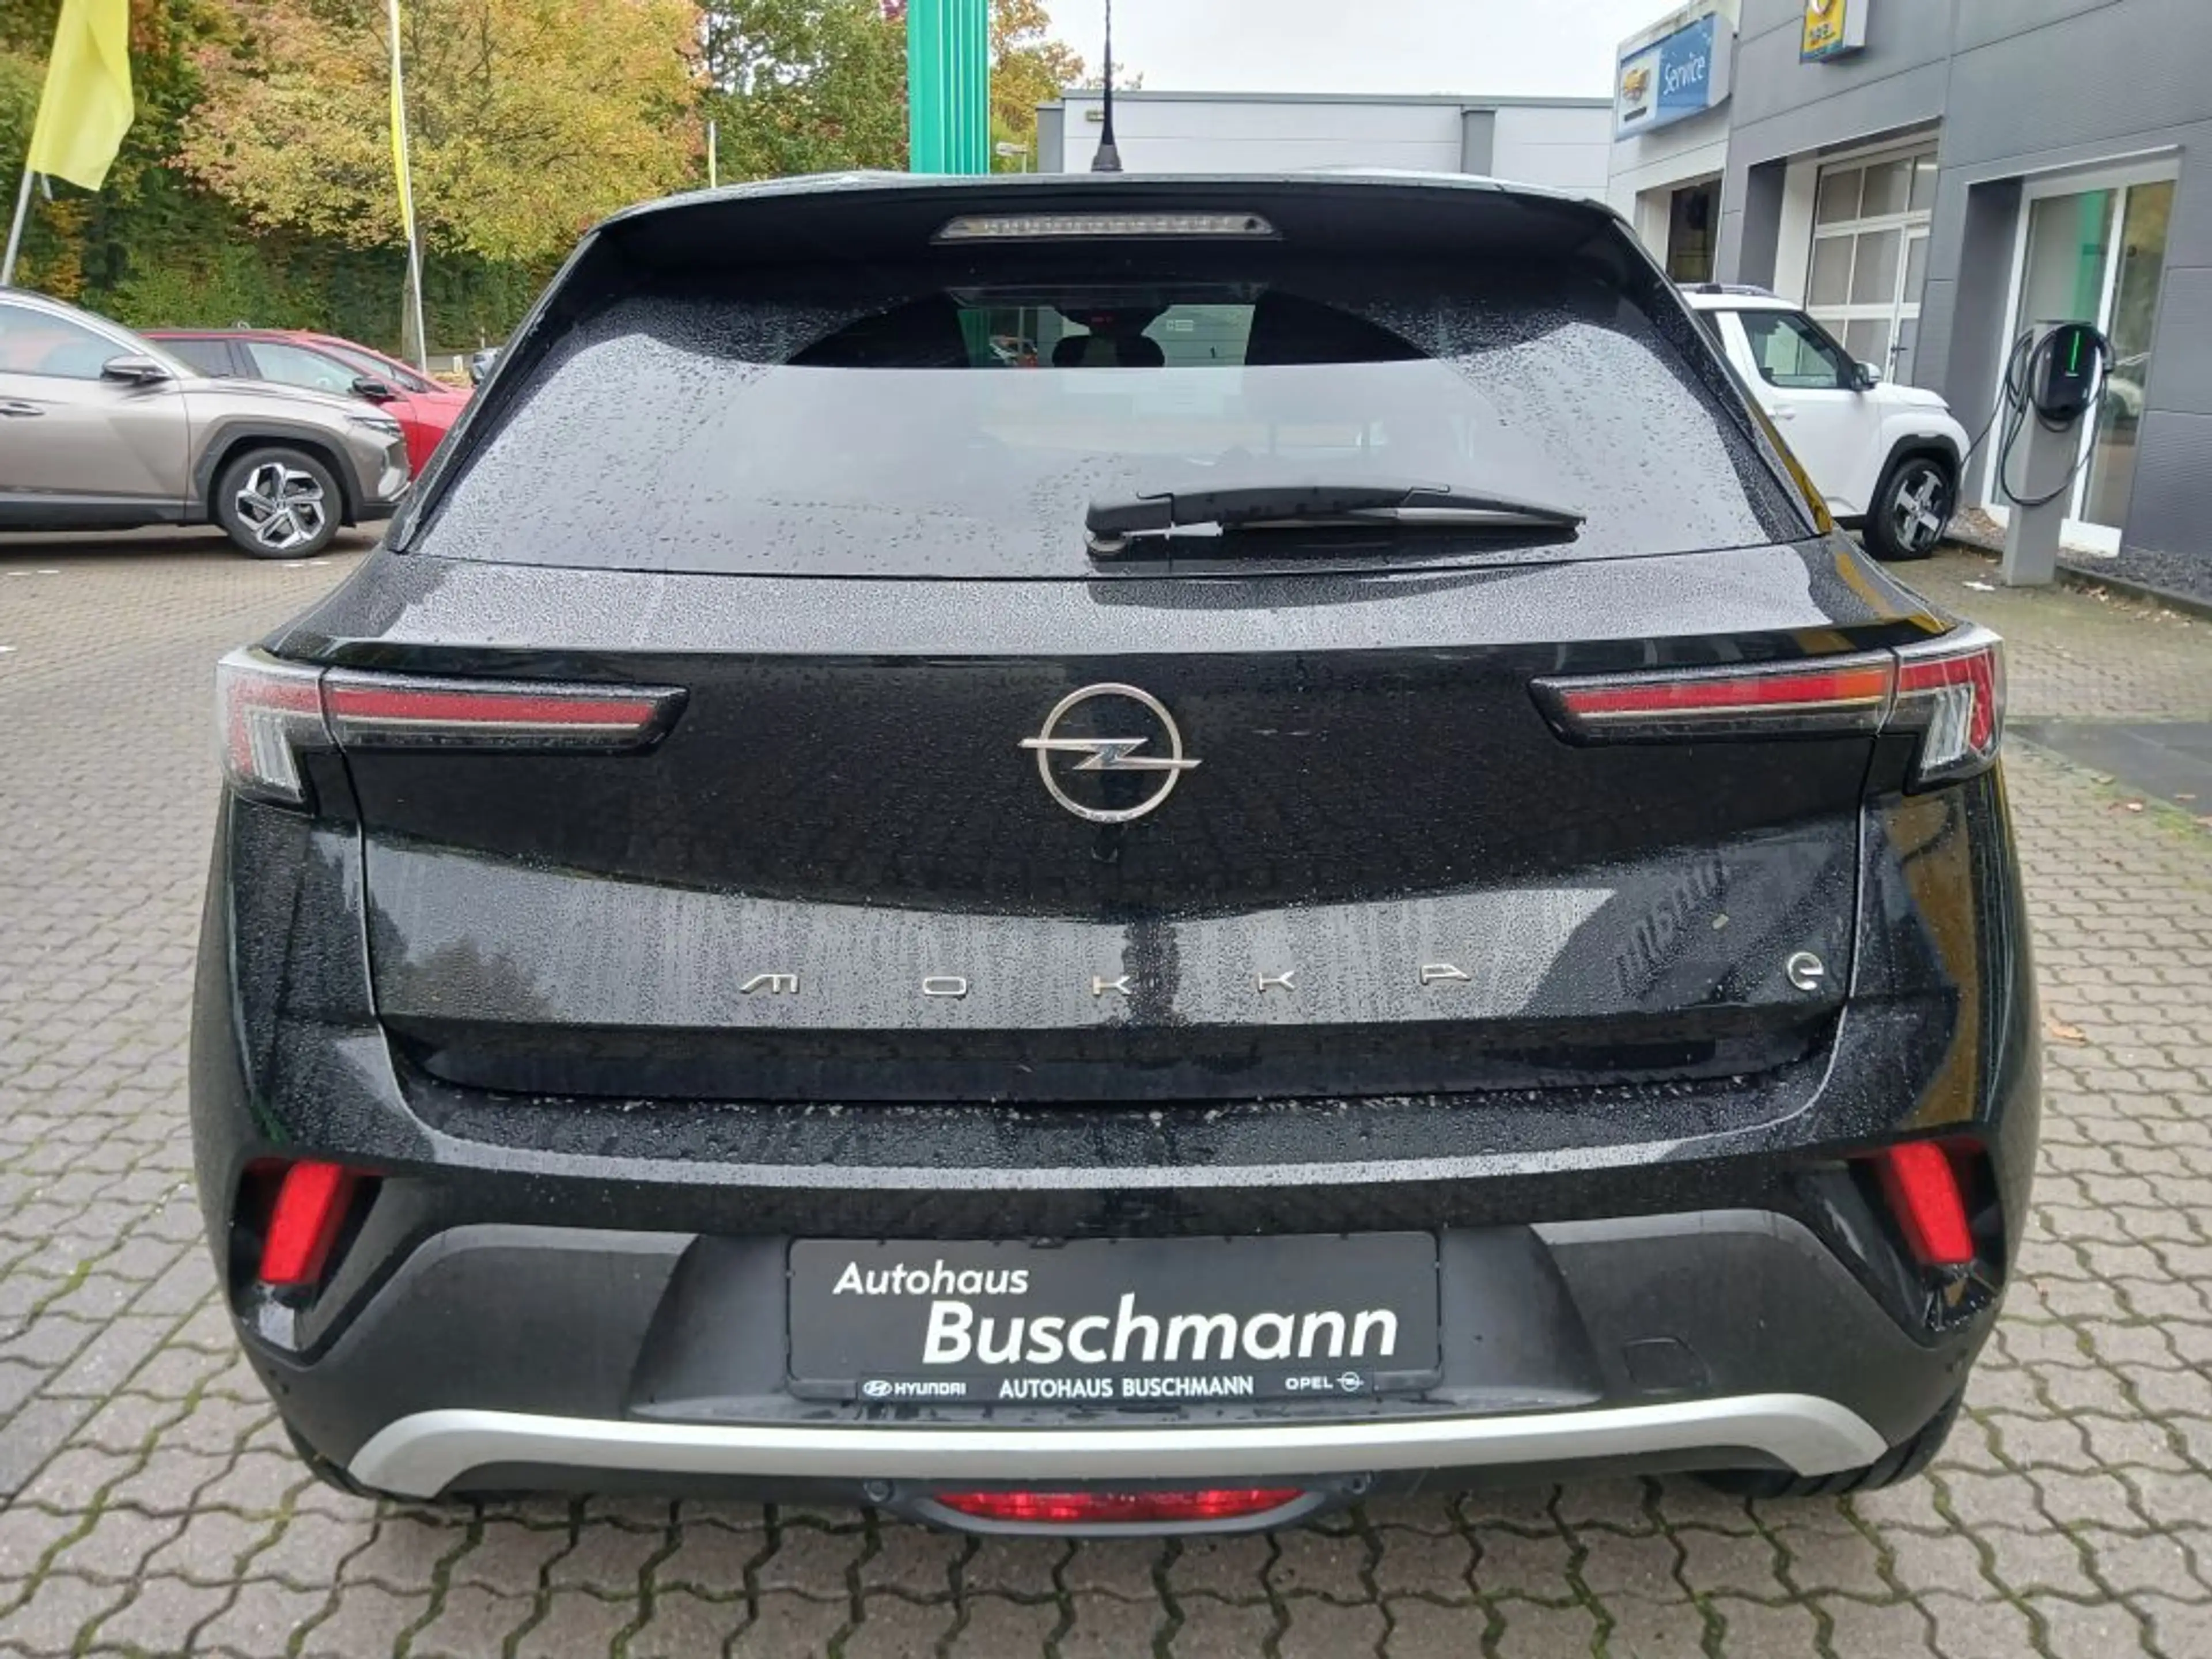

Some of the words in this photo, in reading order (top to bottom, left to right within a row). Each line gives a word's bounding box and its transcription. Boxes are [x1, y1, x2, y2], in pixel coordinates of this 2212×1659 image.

[1662, 51, 1706, 96] Service
[740, 964, 1471, 997] MOKKA
[832, 1259, 1029, 1295] Autohaus
[922, 1291, 1398, 1365] Buschmann
[895, 1382, 967, 1396] HYUNDAI
[999, 1378, 1113, 1399] AUTOHAUS
[1123, 1376, 1254, 1398] BUSCHMANN
[1285, 1376, 1334, 1391] OPEL
